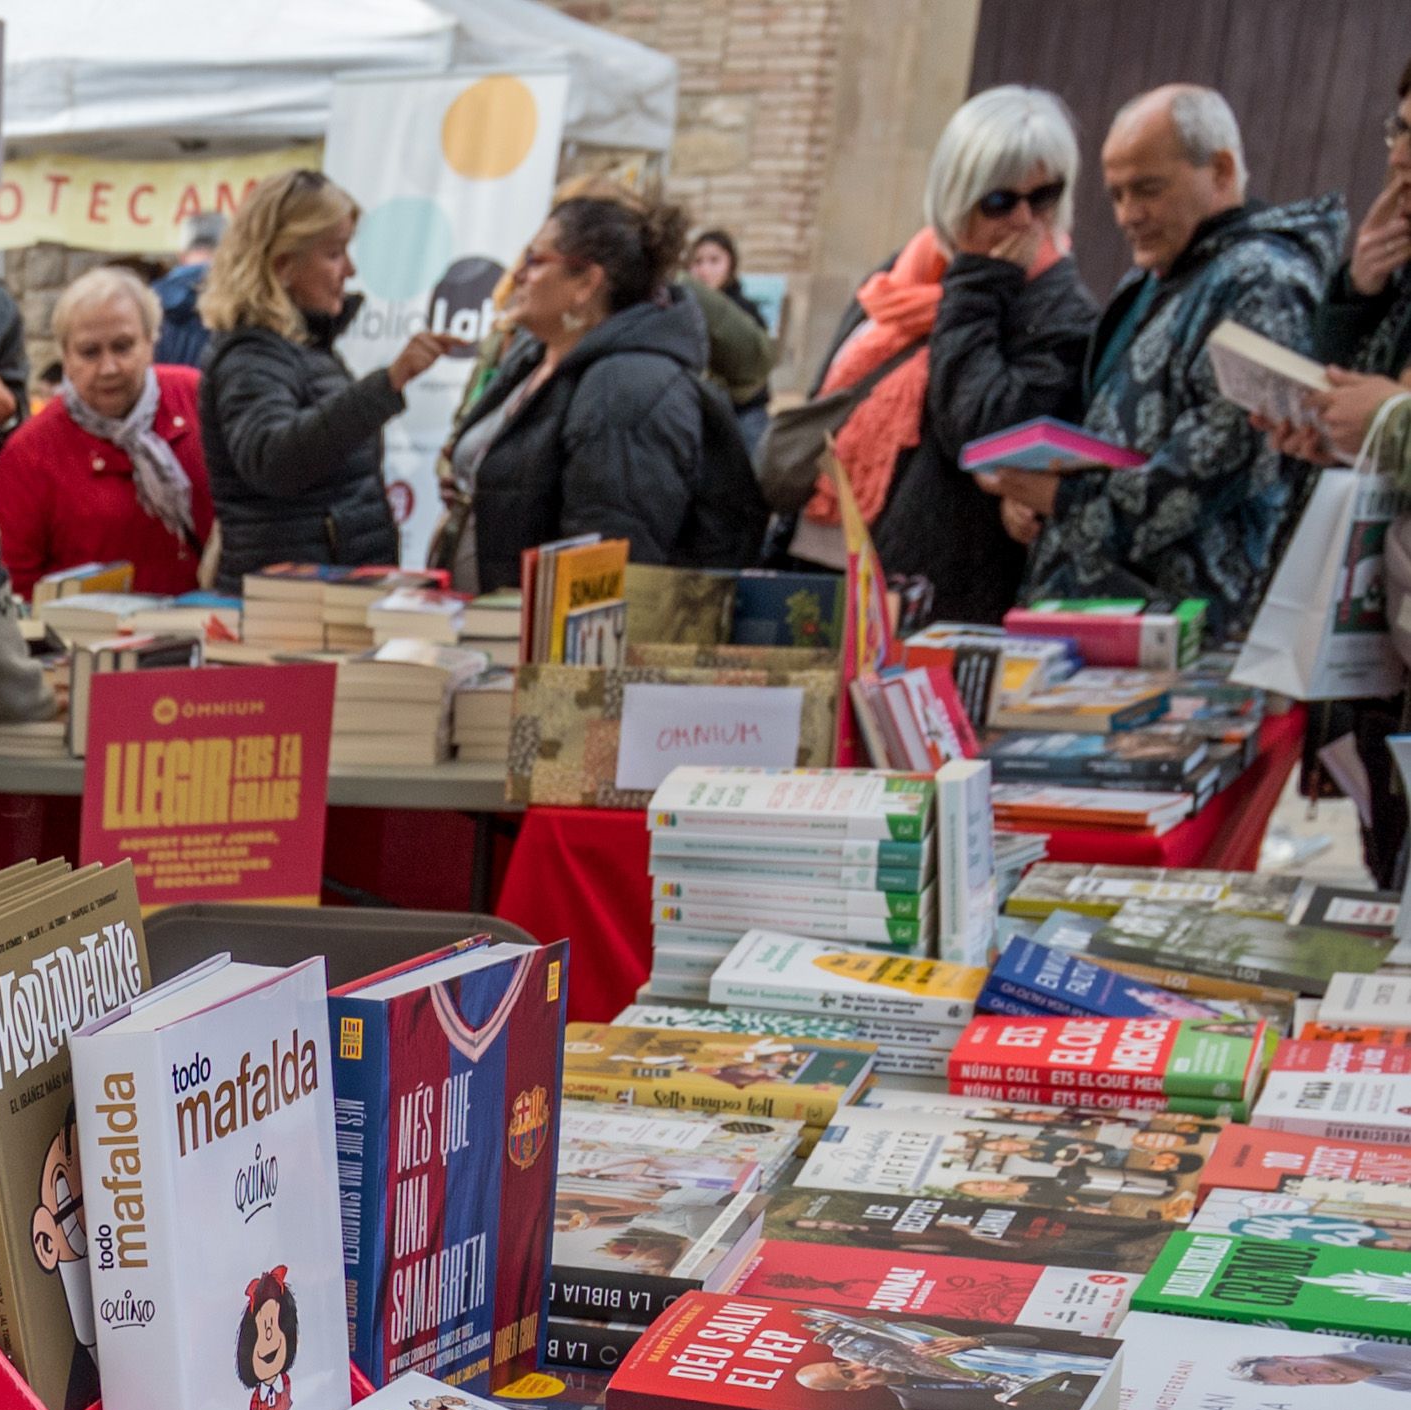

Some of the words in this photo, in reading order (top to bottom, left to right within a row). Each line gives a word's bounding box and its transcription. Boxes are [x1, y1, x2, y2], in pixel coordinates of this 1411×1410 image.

[172, 1052, 211, 1094] todo
[177, 1030, 318, 1159] mafalda
[397, 1094, 433, 1173] MÉS
[439, 1070, 473, 1154] QUE
[96, 1071, 151, 1270] mafalda
[395, 1176, 429, 1259] UNA
[97, 1224, 113, 1271] todo
[391, 1231, 486, 1346] SAMARRETA
[561, 1282, 622, 1309] BIBLIA
[697, 1300, 774, 1353] SALVI
[743, 1327, 809, 1370] PEP
[667, 1345, 734, 1383] DÉU
